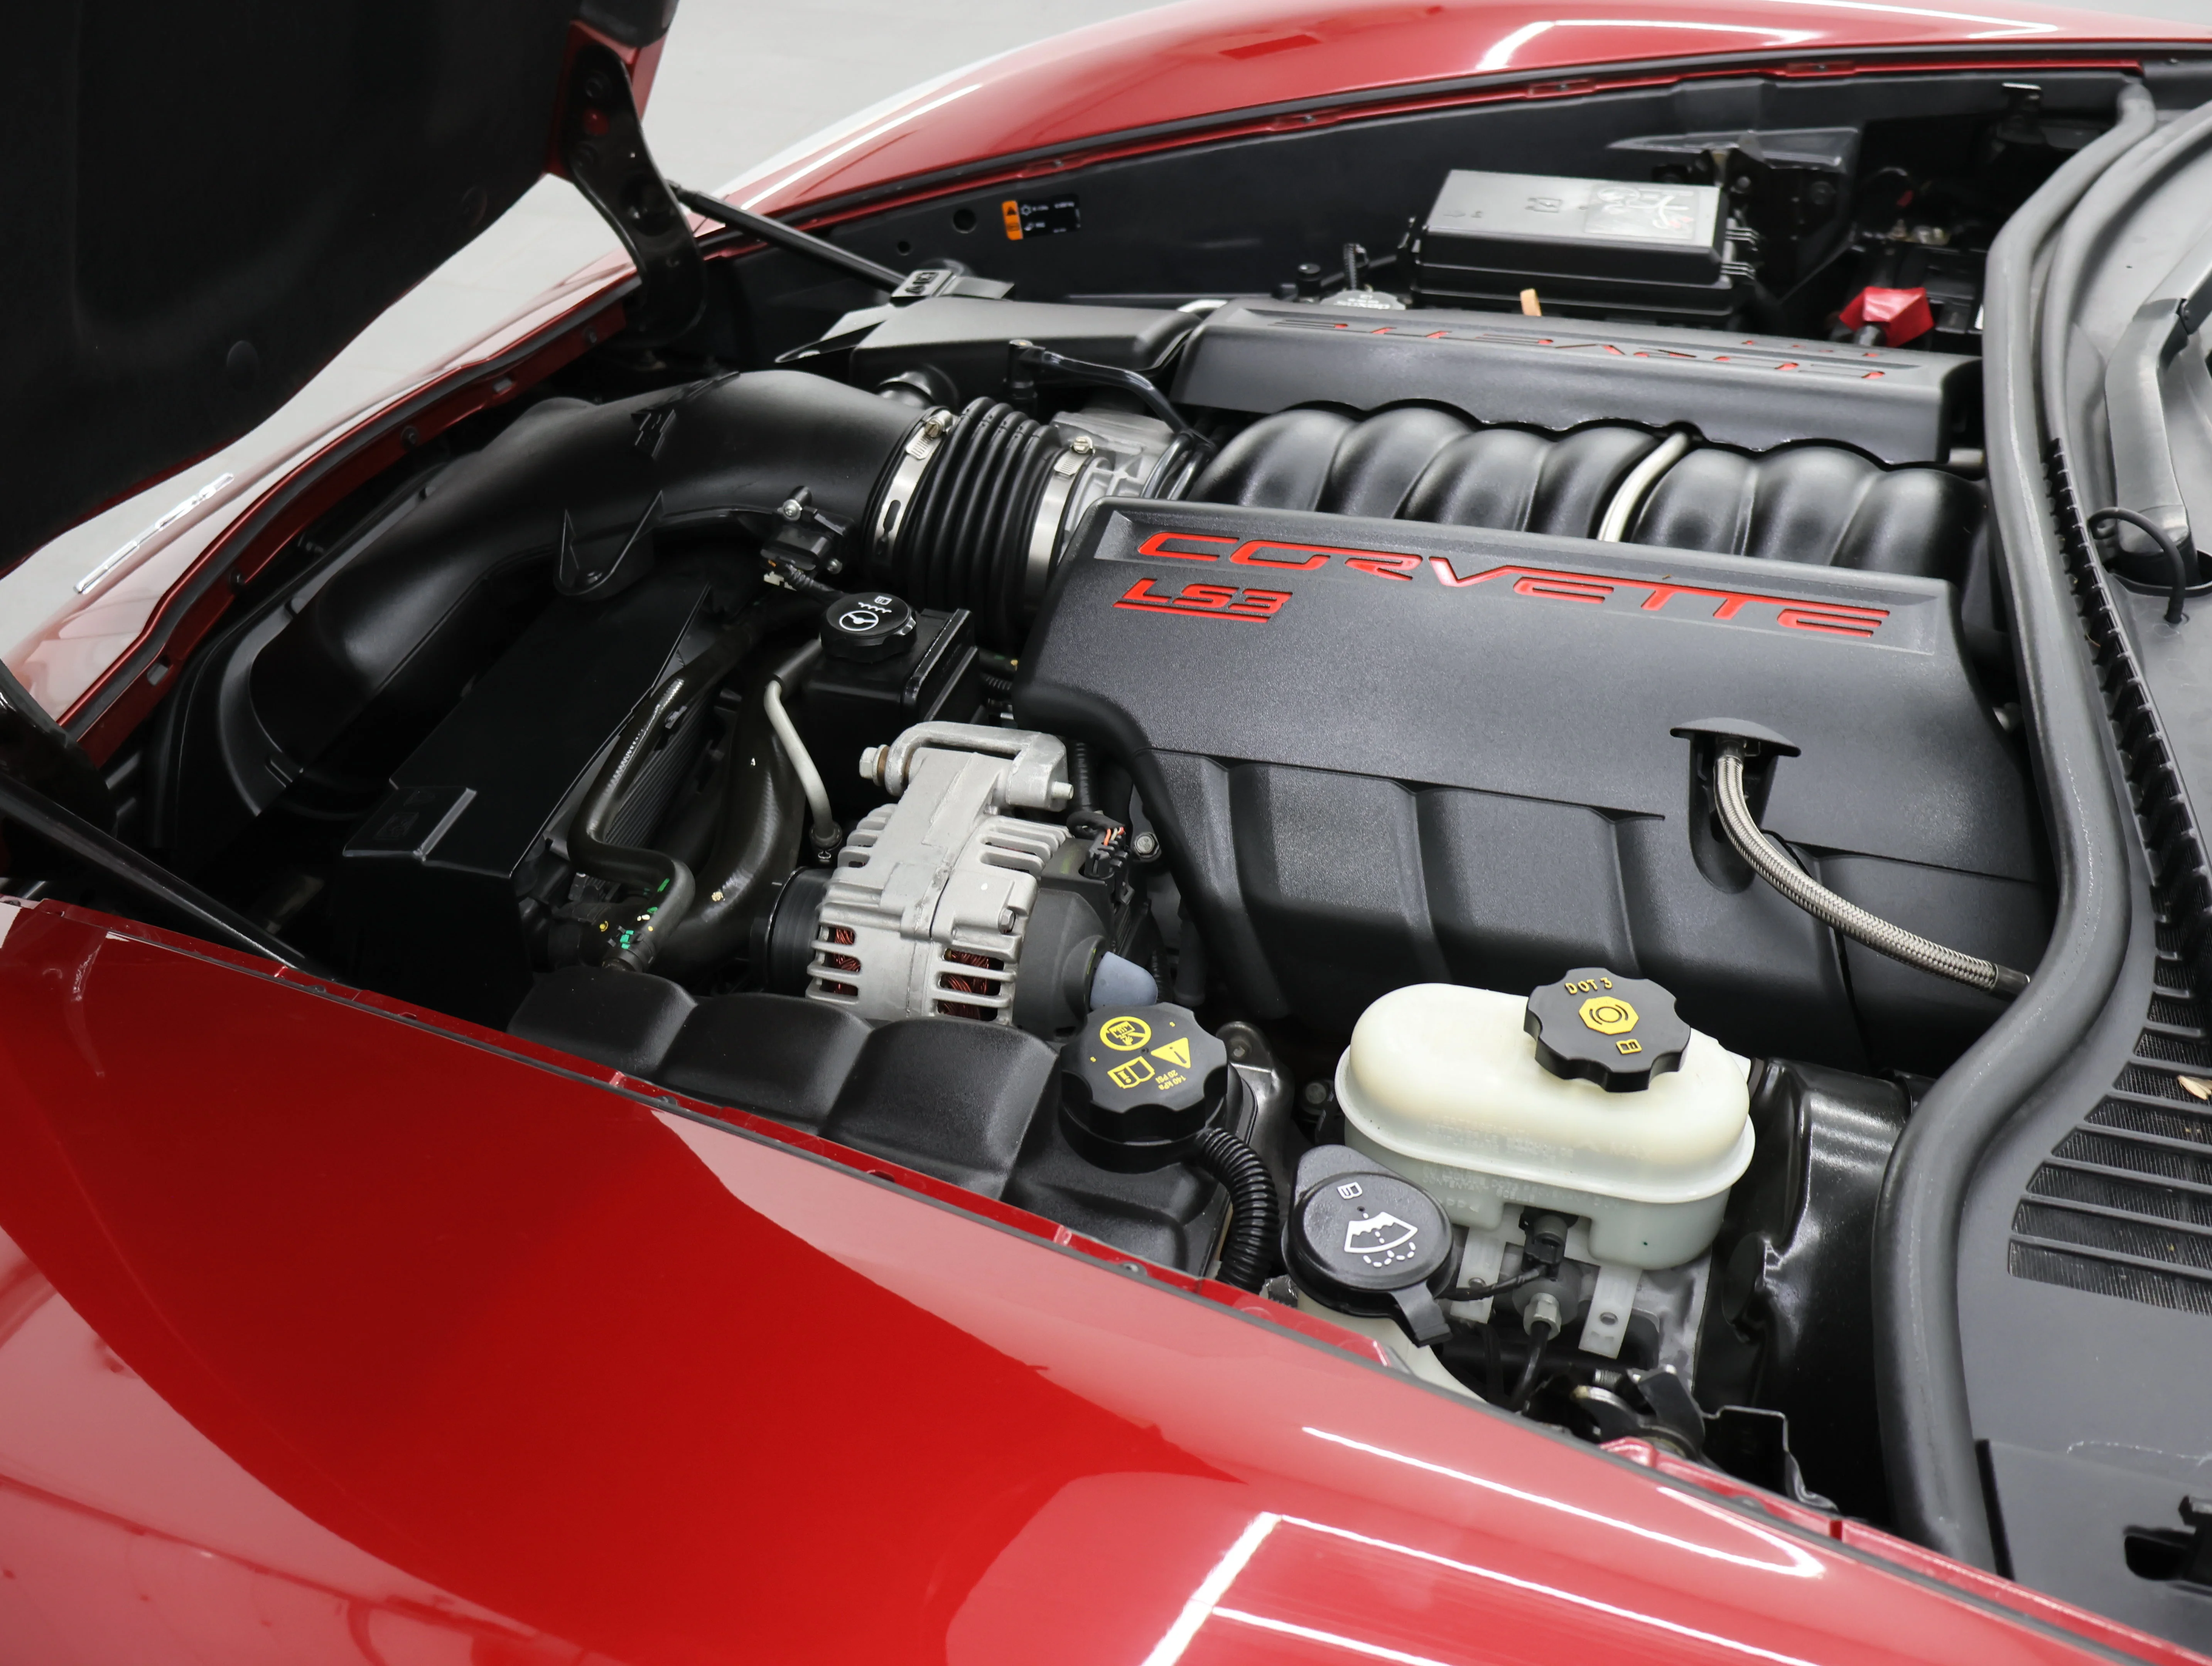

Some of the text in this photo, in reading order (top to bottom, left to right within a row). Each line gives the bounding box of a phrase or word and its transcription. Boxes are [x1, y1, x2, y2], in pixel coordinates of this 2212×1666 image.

[1122, 578, 1293, 614] LS3
[1138, 532, 1890, 637] CORVETTE
[1564, 977, 1613, 995] DOT 3
[1155, 1070, 1178, 1084] 20 PSI
